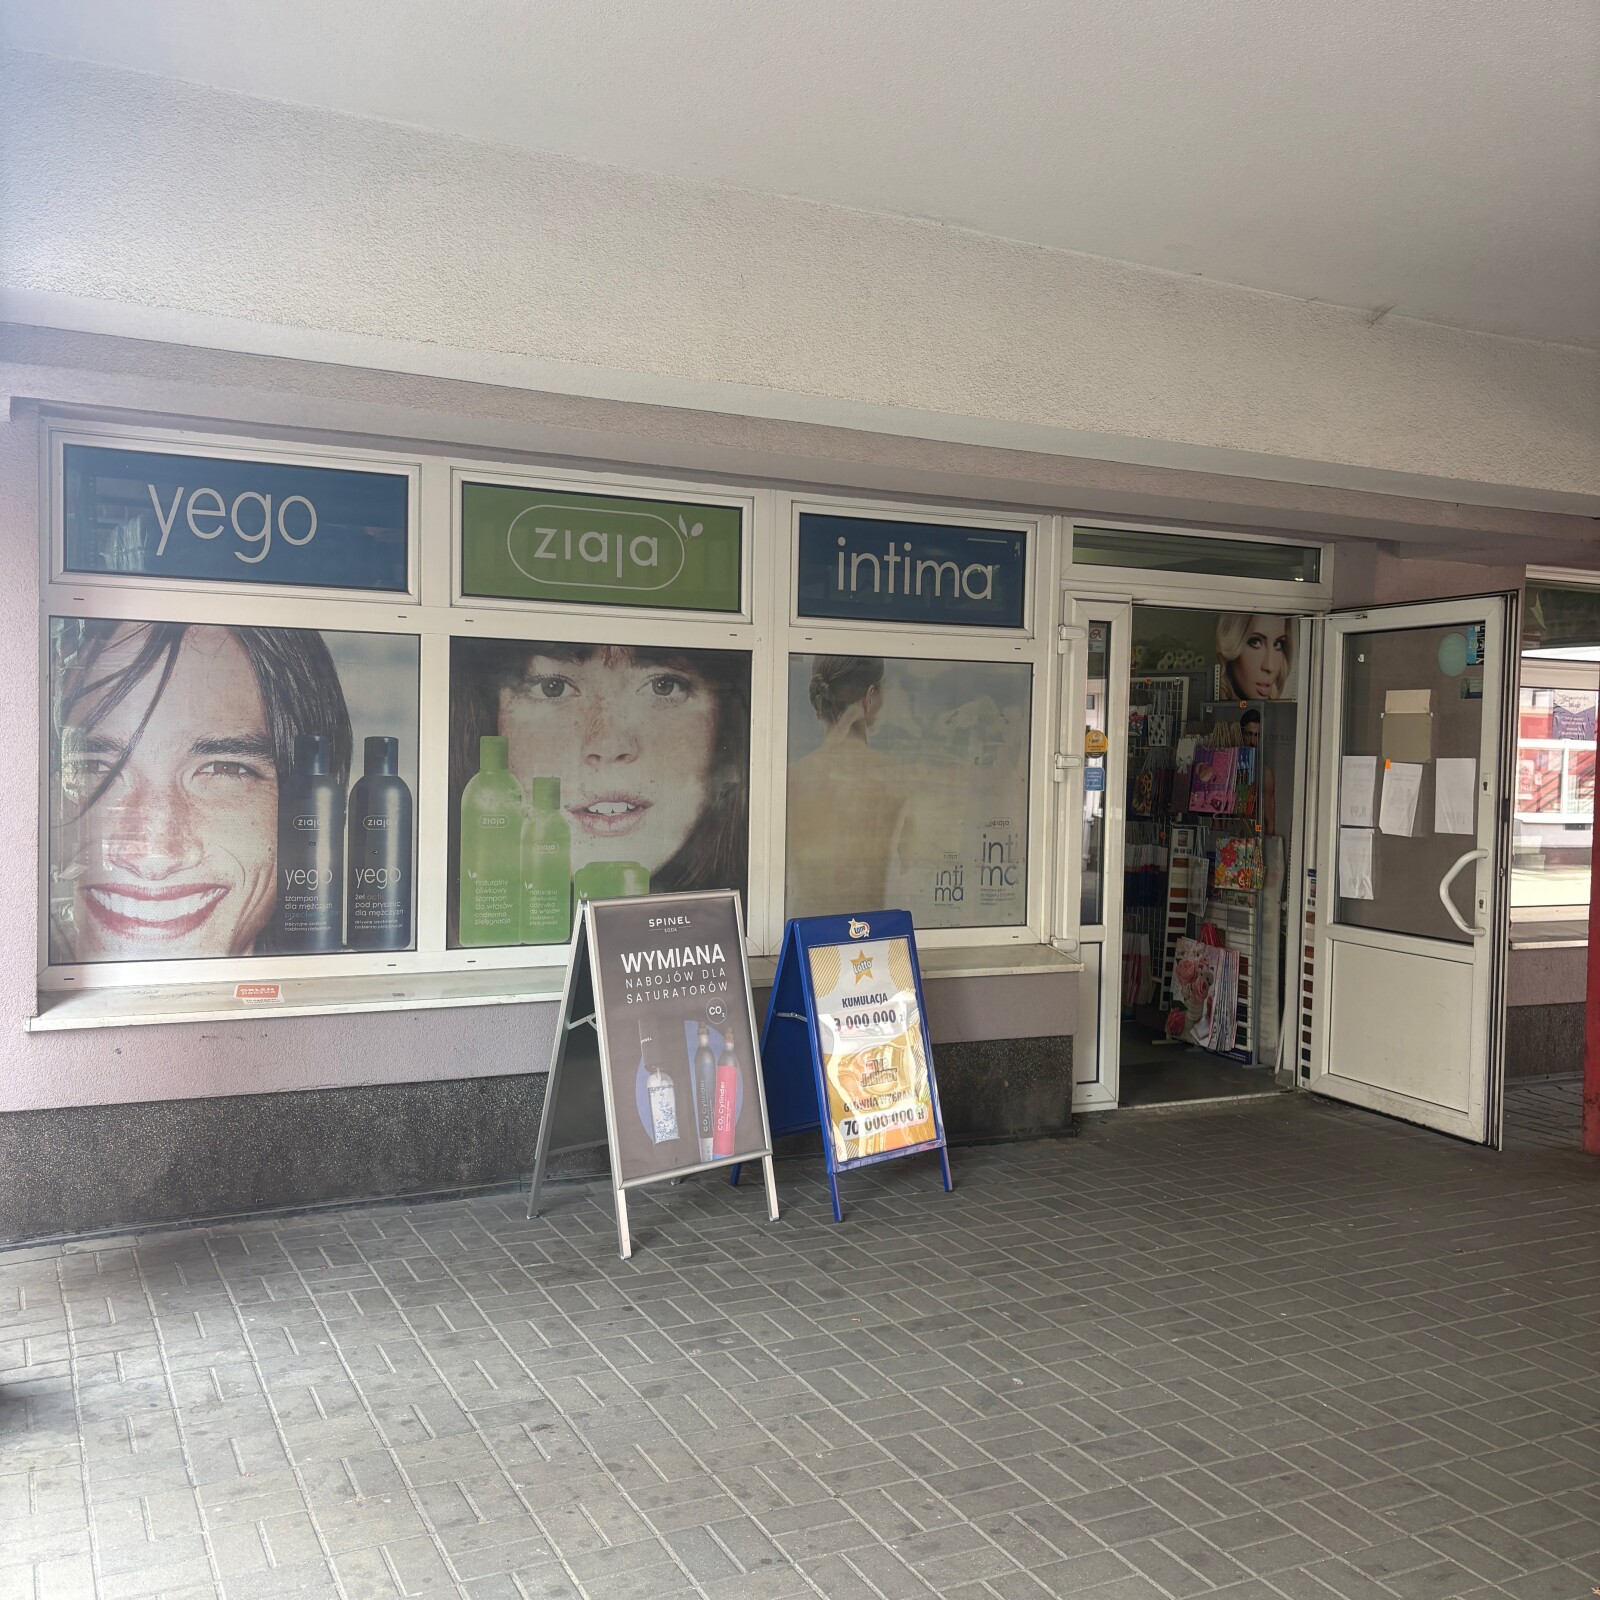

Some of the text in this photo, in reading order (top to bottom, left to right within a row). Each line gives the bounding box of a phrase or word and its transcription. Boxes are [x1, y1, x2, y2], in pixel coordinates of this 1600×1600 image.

[147, 483, 318, 564] yego
[533, 527, 658, 578] ziaja
[837, 536, 993, 600] intima
[482, 817, 505, 827] ziaja
[285, 868, 333, 891] yego
[355, 867, 402, 889] yego
[936, 865, 964, 886] inti
[284, 895, 319, 903] szampon
[475, 895, 507, 903] szampon
[934, 886, 964, 902] ma
[284, 902, 297, 910] dla
[648, 915, 691, 928] SPINEL
[620, 943, 726, 974] WYMIANA
[852, 959, 873, 974] Lotto
[625, 967, 726, 989] NABOJÓW DLA
[626, 980, 729, 1004] SATURATORÓW
[841, 992, 888, 1008] KUMULACJA
[845, 1012, 870, 1030] 000
[872, 1008, 897, 1025] 000
[700, 1080, 709, 1114] Cylinder
[717, 1081, 726, 1114] Cylinder
[844, 1107, 925, 1136] 70 000 000 zł
